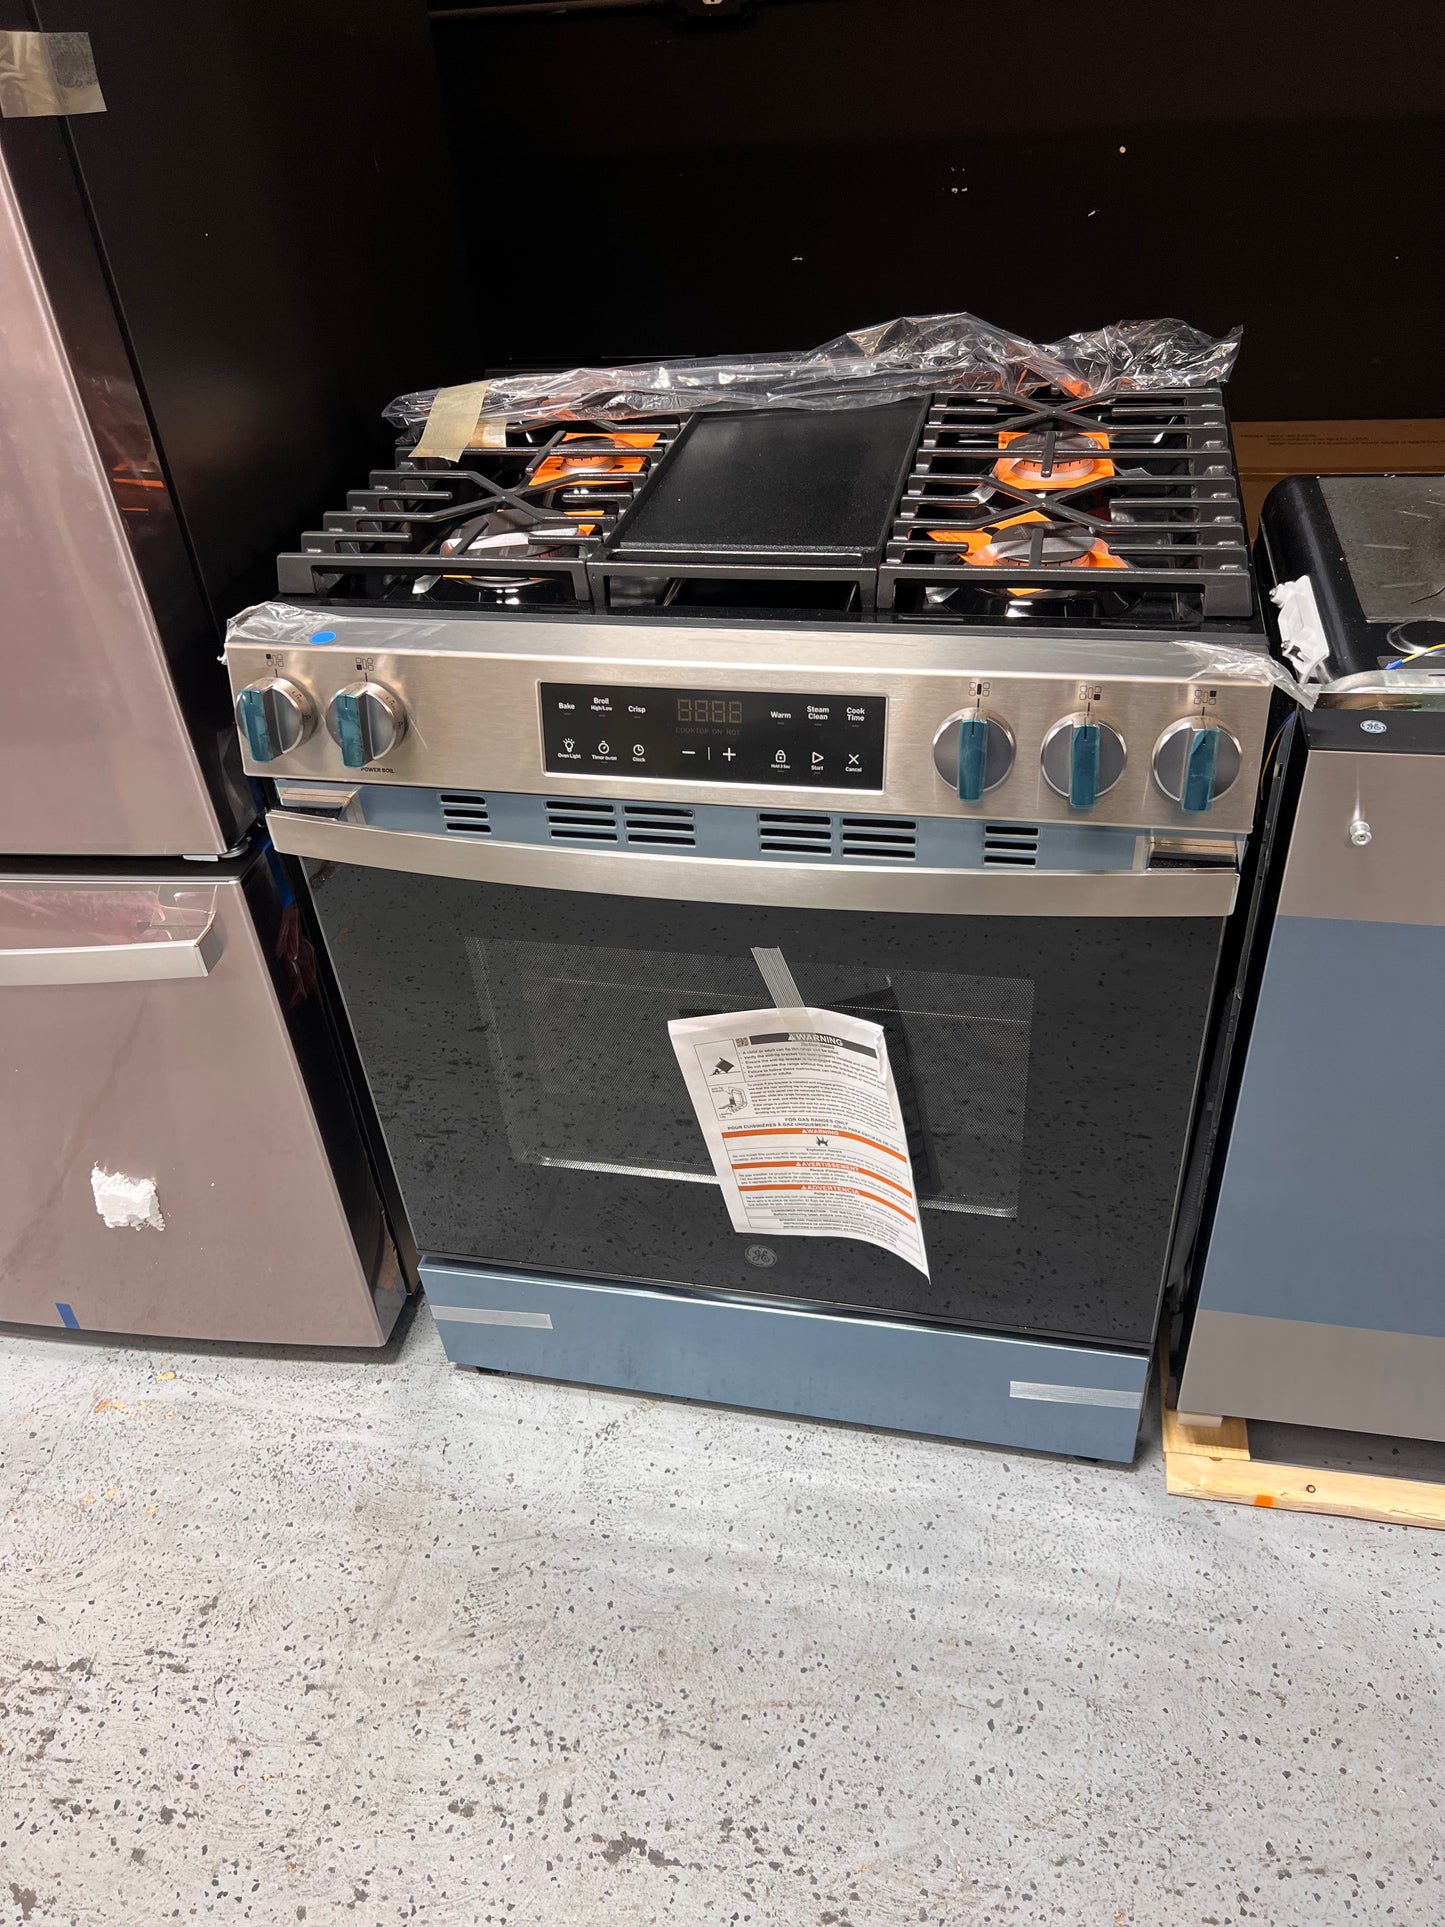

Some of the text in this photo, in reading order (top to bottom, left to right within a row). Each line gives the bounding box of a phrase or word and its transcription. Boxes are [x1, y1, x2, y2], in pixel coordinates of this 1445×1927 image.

[593, 697, 609, 705] Broil
[558, 702, 575, 710] Bake
[628, 705, 646, 714] Crisp
[806, 705, 829, 713] Steam
[770, 711, 791, 719] Warm
[795, 1033, 843, 1046] WARNING
[801, 1161, 859, 1172] AVERTISSEMENT
[807, 1185, 859, 1195] ADVERTENCIA
